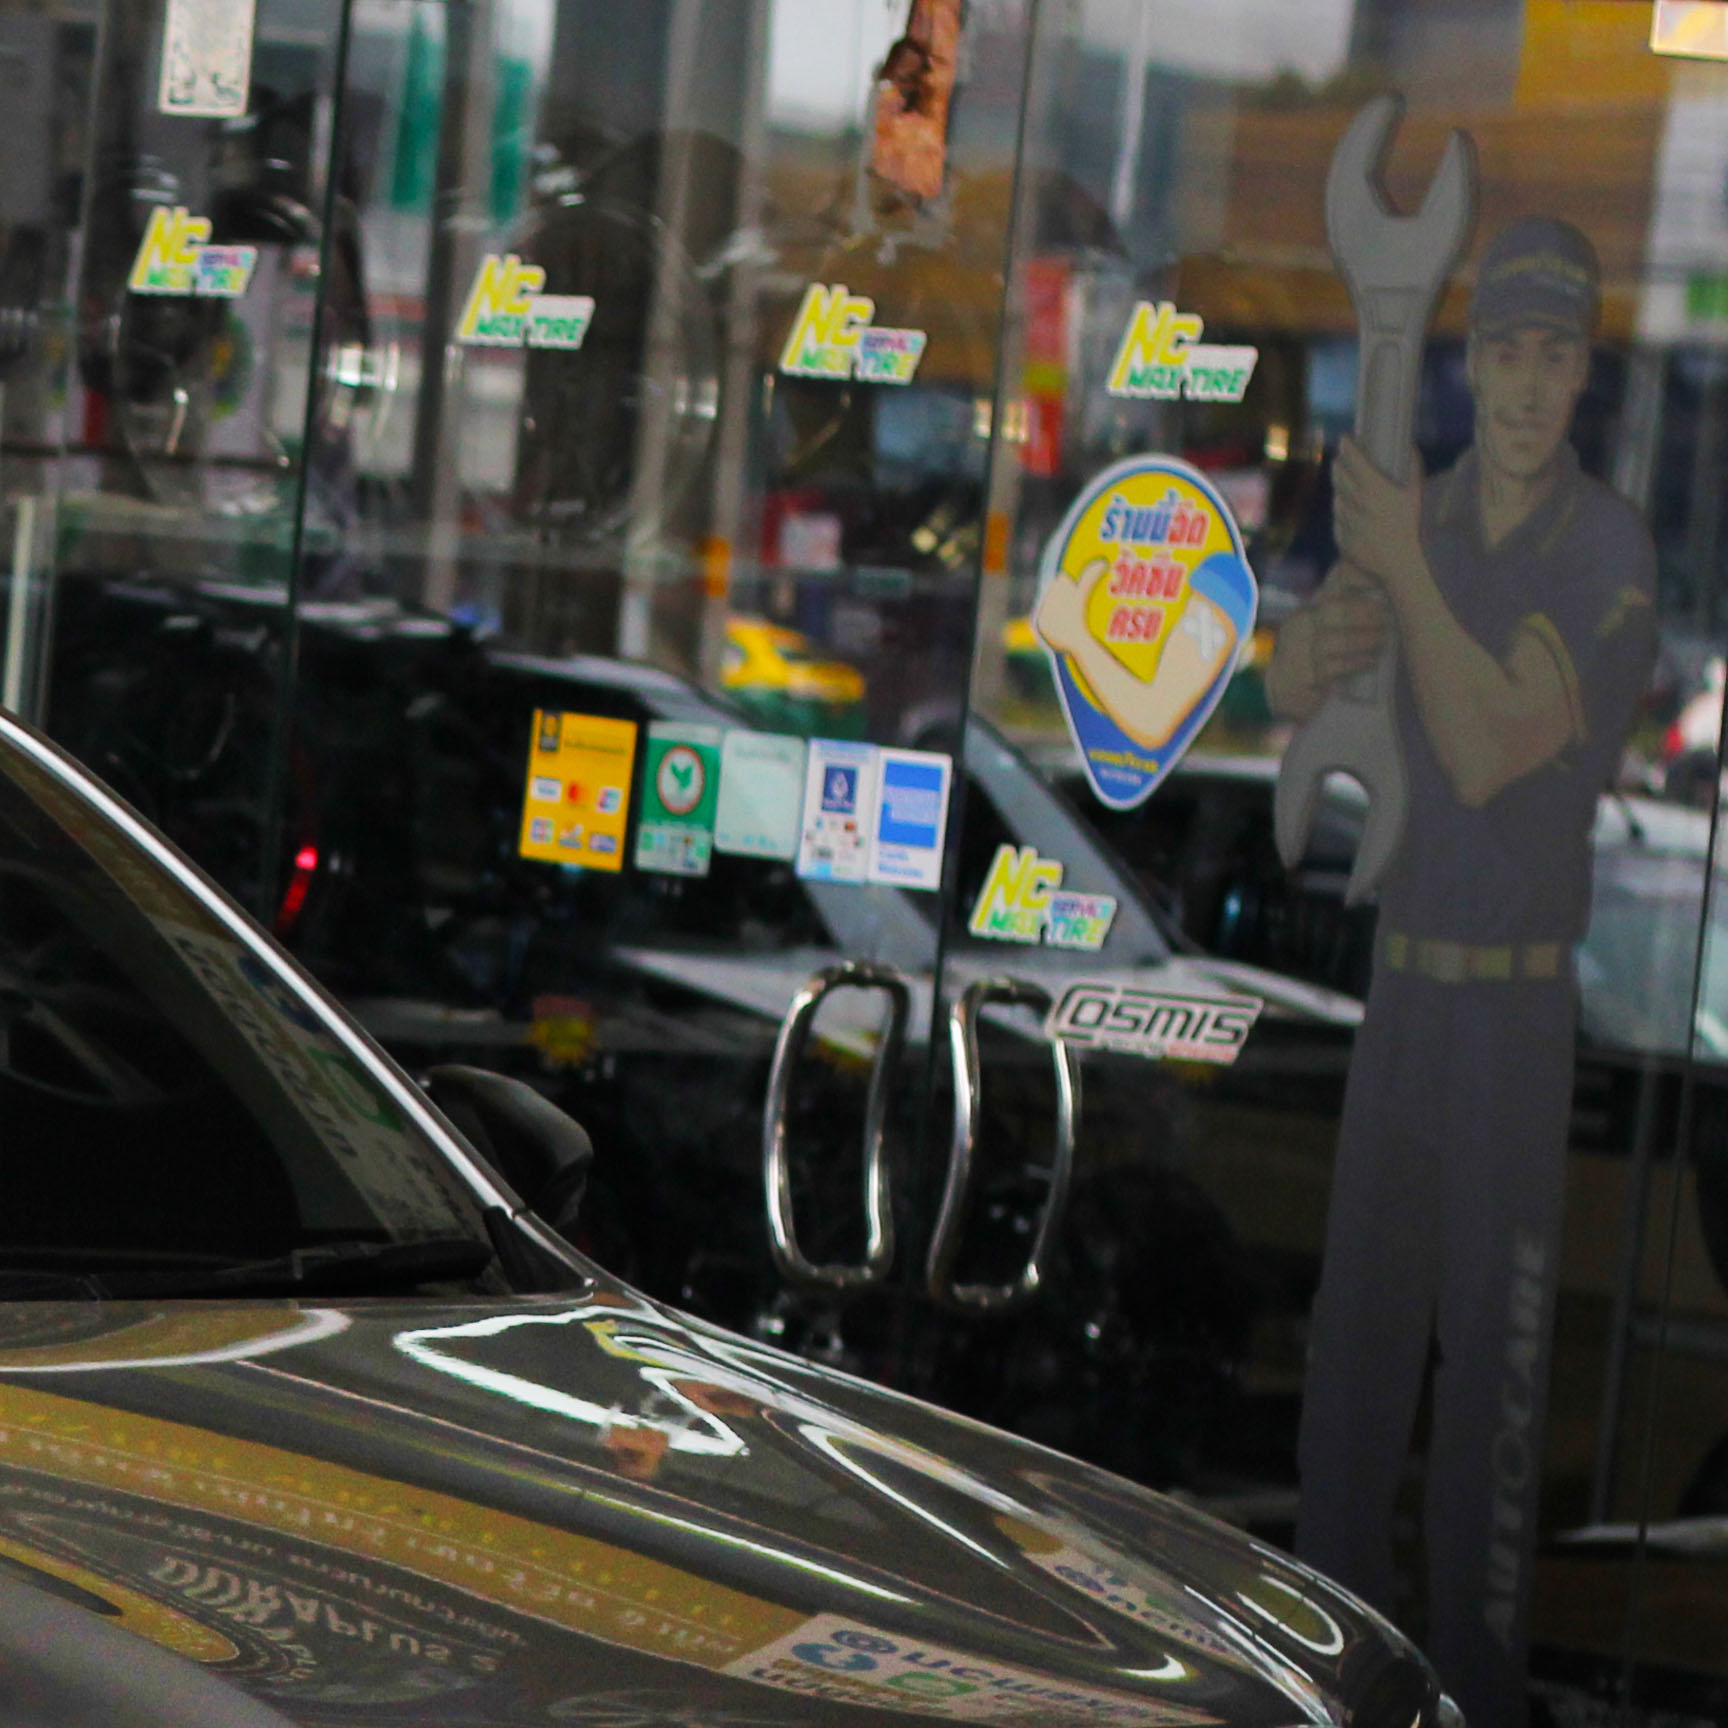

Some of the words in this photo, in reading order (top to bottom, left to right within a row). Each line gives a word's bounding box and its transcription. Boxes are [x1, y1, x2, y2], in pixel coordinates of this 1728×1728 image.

[462, 259, 542, 336] NC
[785, 287, 872, 368] NC
[1111, 306, 1201, 389] NC
[1108, 608, 1164, 641] ครบ
[972, 849, 1062, 929] NC
[1055, 982, 1258, 1046] COSMIS
